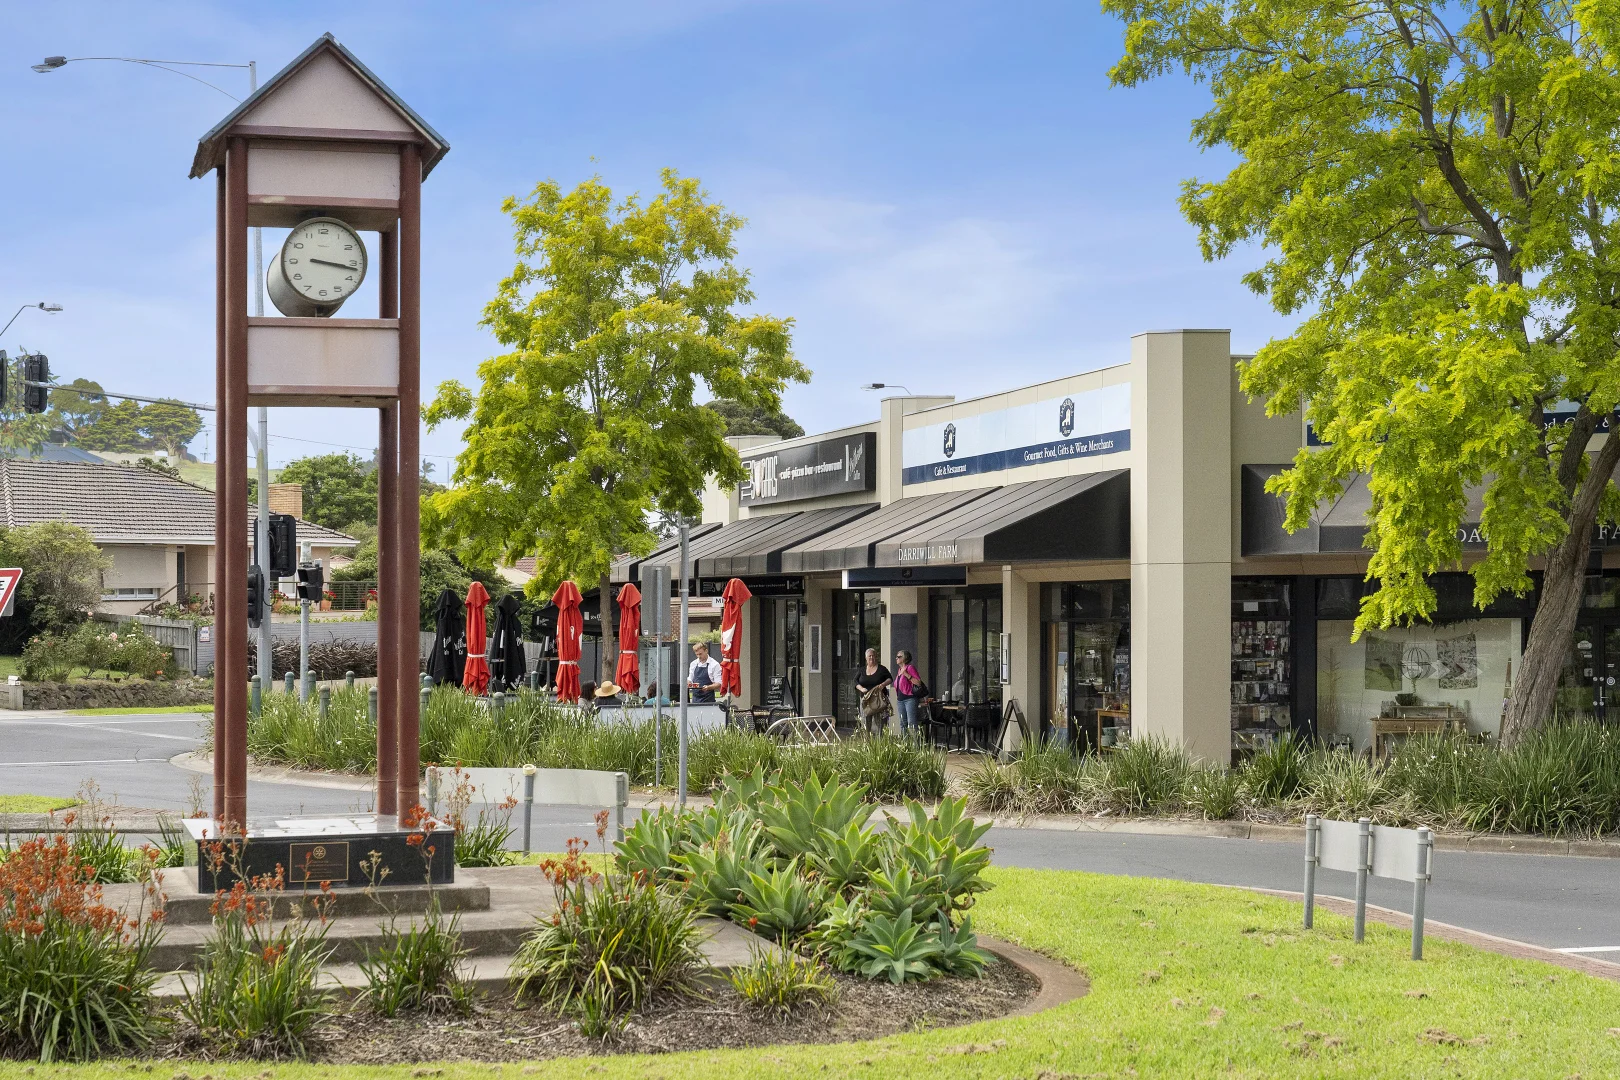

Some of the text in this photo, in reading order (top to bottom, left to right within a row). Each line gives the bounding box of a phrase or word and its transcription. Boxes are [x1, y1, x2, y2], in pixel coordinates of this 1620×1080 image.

[1024, 438, 1114, 462] Gourmet Food, Gifts & Wine Merchants
[934, 464, 966, 476] Cafe & Restaurant
[898, 544, 958, 560] DARRIWILL FARM
